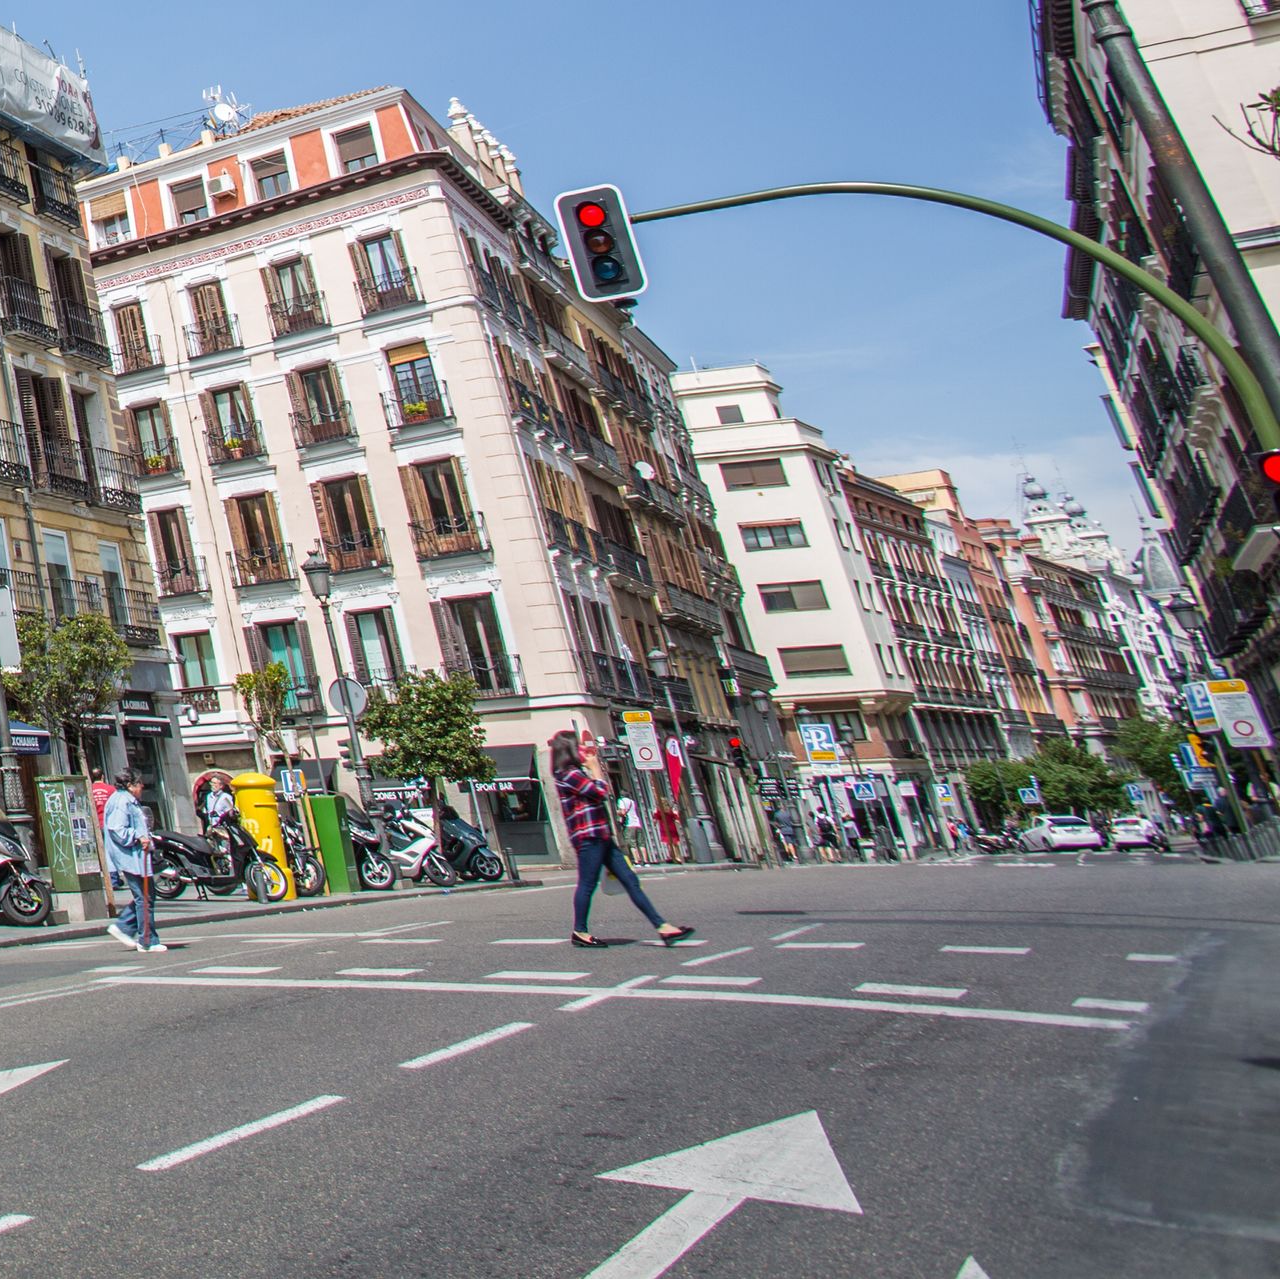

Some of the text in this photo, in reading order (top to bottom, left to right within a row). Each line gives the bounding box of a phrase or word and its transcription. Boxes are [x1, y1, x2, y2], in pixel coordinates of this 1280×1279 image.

[11, 737, 39, 747] XCHANGE
[807, 729, 828, 751] P
[499, 782, 515, 791] BAR
